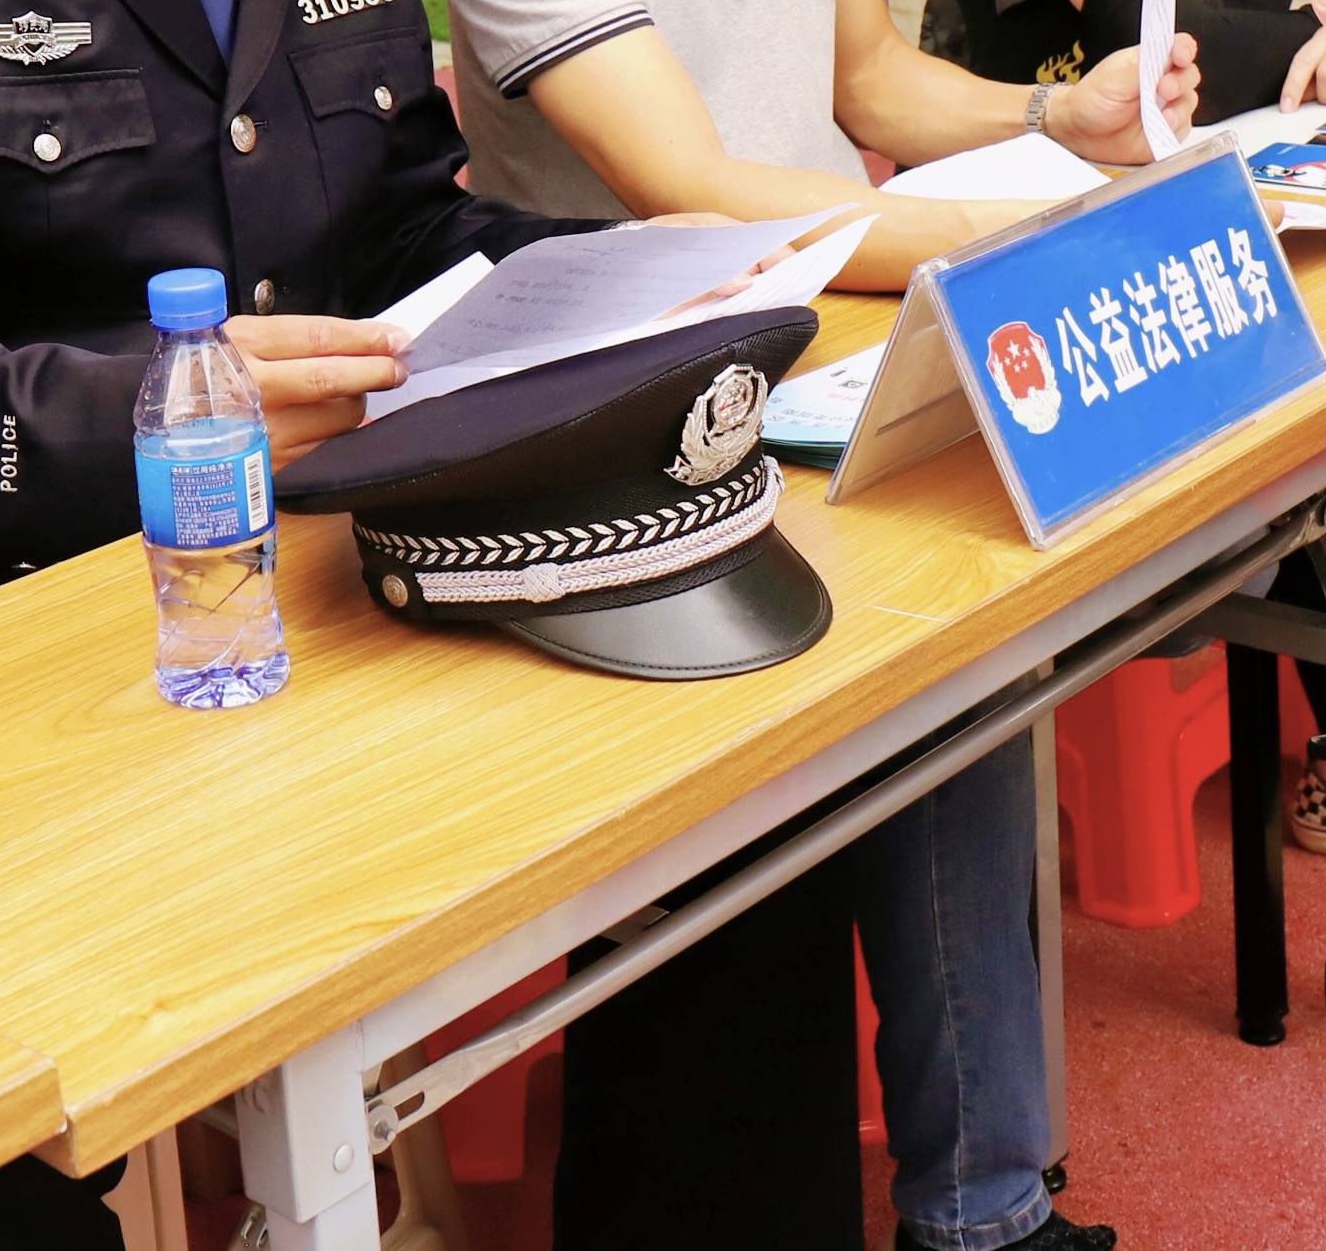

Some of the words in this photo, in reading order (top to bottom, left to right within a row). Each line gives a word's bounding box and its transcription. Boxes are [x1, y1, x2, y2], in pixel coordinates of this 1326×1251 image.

[1054, 226, 1279, 408] 公益法律服务
[0, 414, 20, 493] POLICE
